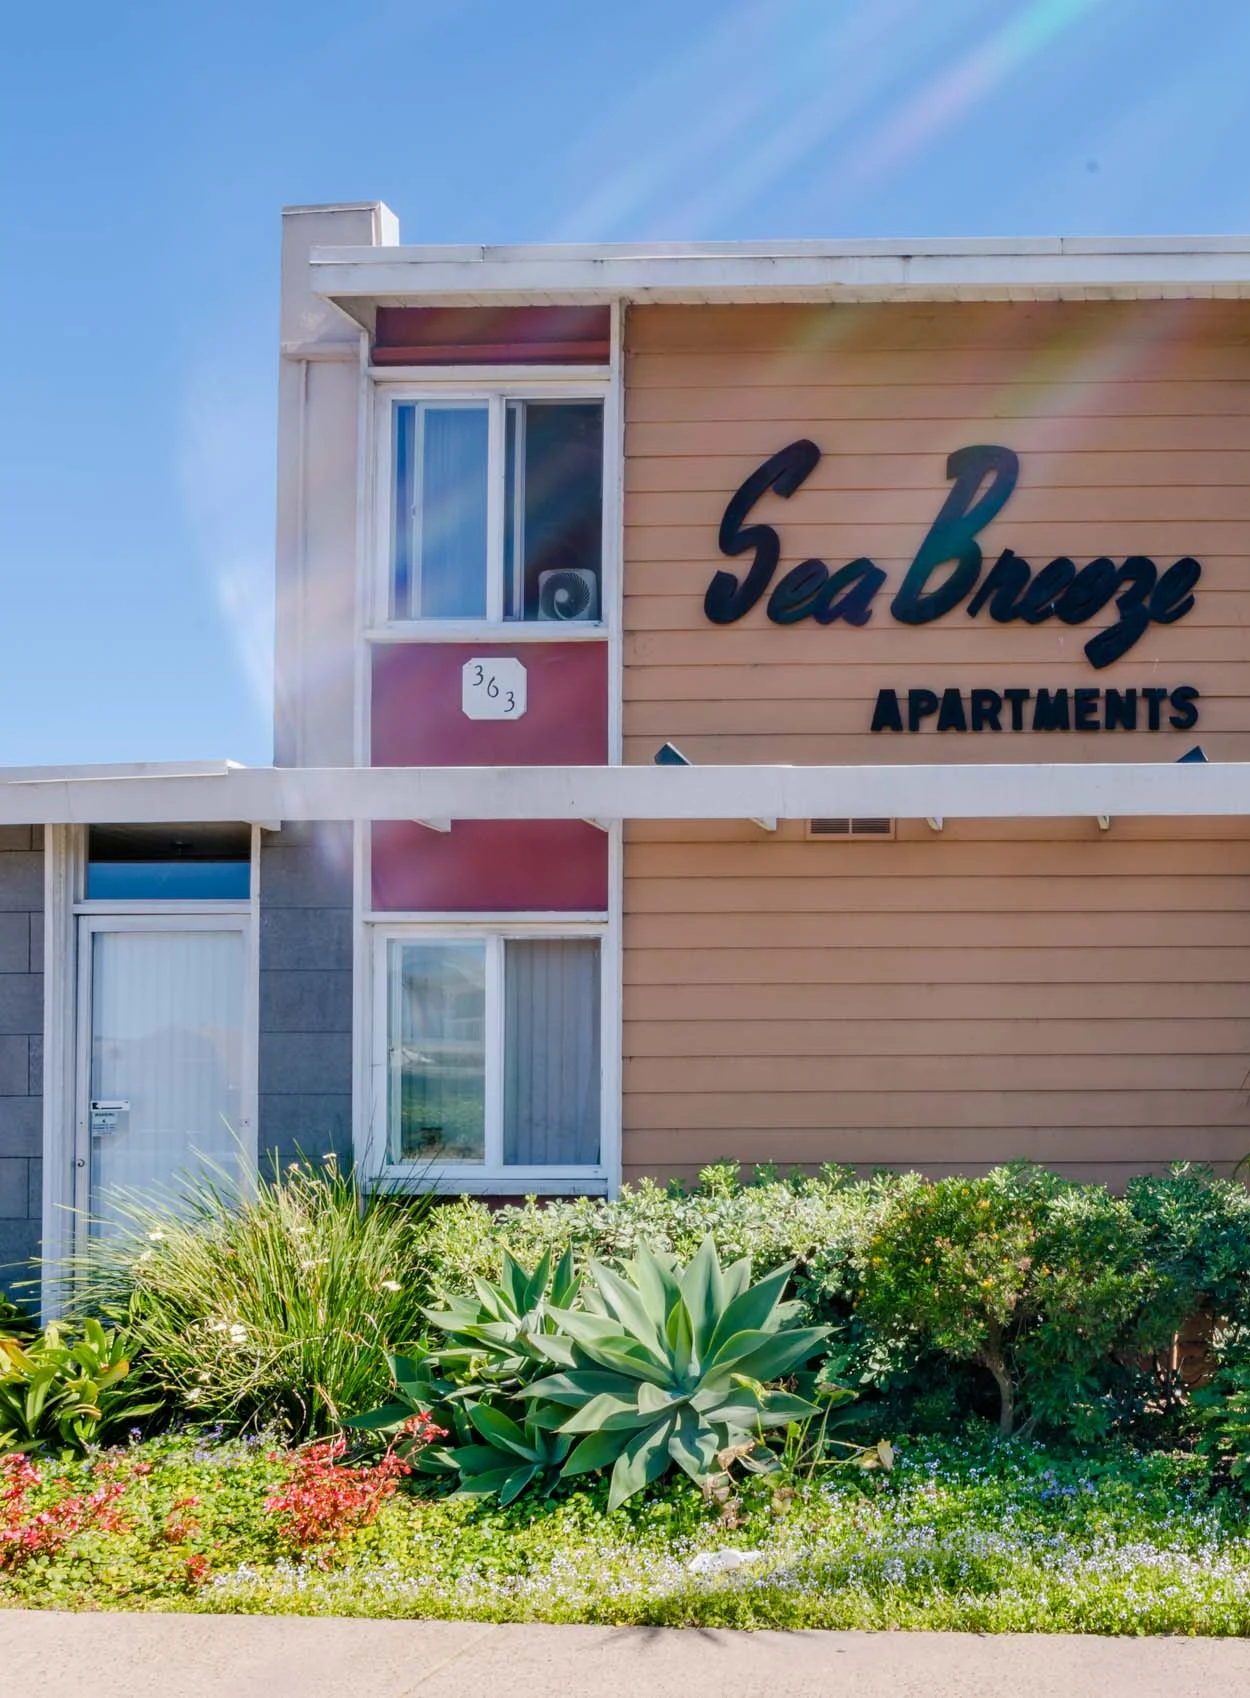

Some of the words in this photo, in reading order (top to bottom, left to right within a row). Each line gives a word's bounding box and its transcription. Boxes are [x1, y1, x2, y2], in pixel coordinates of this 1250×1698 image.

[704, 439, 887, 625] Sea
[890, 445, 1202, 669] Breeze
[472, 665, 515, 713] 363
[870, 687, 1201, 731] APARTMENTS
